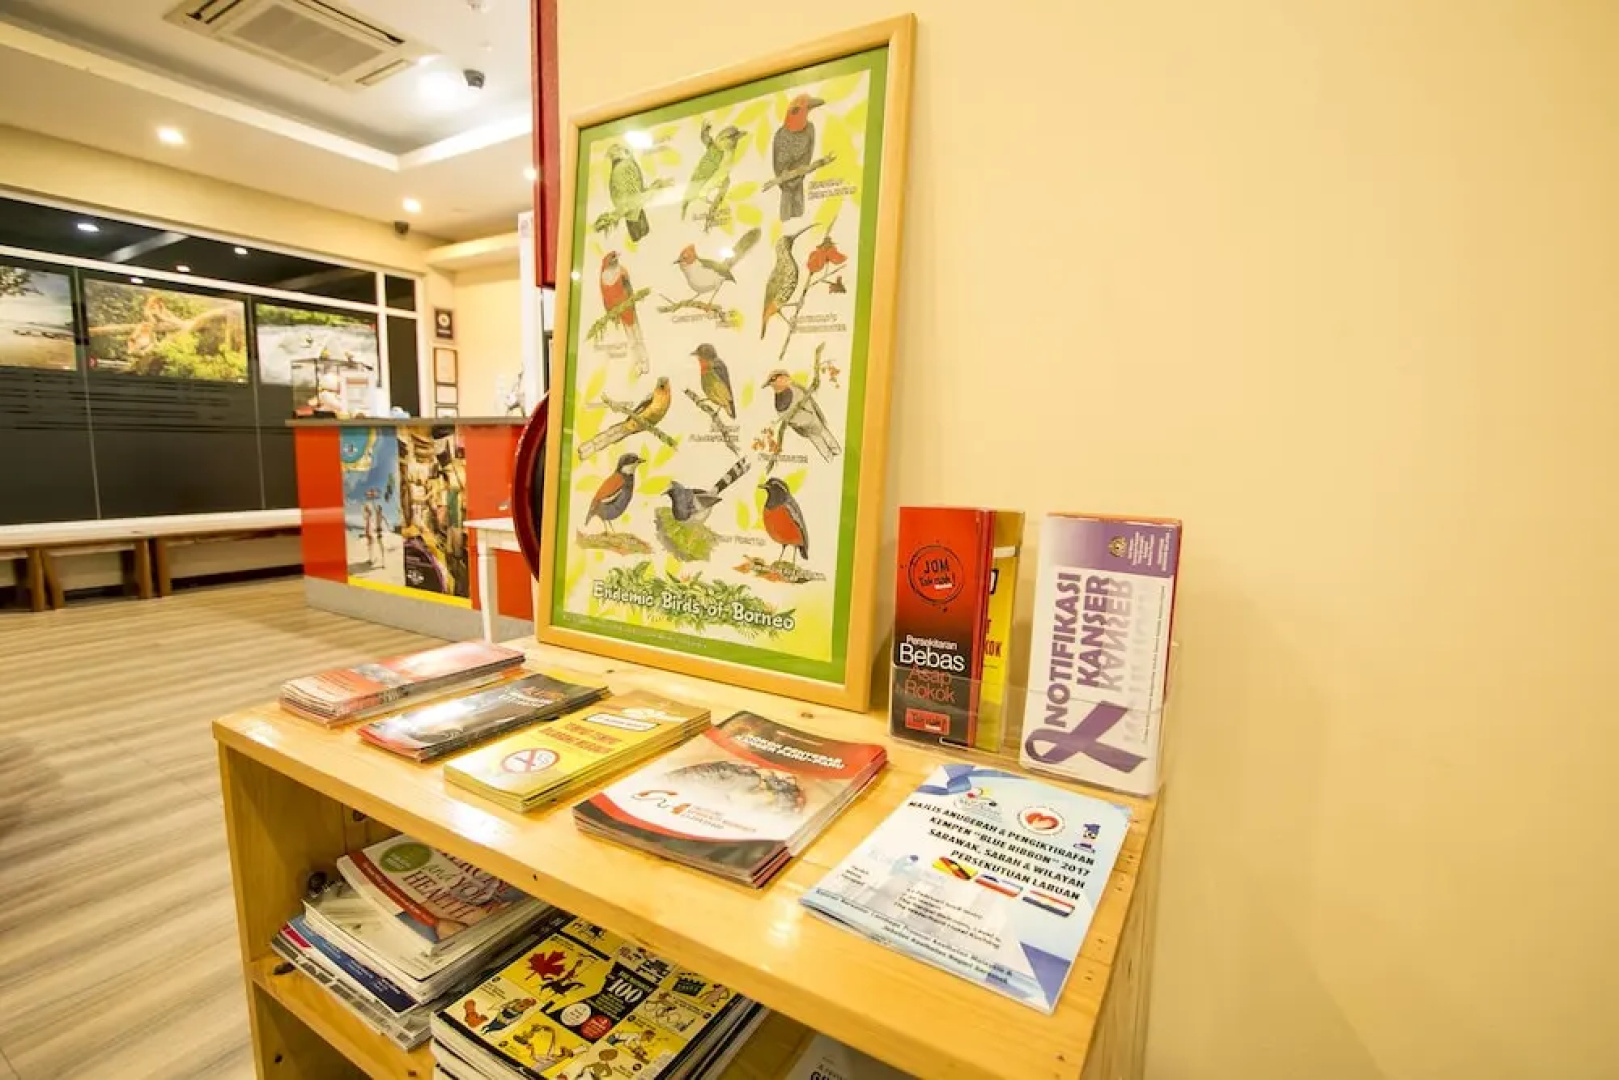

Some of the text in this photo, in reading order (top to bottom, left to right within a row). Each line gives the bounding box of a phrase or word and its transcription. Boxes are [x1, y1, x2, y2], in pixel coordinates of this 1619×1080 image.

[924, 558, 949, 574] JOM
[593, 580, 795, 630] Endemic Birds of Borneo
[906, 634, 958, 651] Persekitaran
[1044, 572, 1082, 729] NOTIFIKASI
[1076, 575, 1110, 688] KANSER
[899, 642, 966, 672] Bebas
[909, 664, 951, 686] Asap
[905, 680, 956, 704] Rokok
[928, 828, 1086, 889] SARAWAK, SABAH & WILAYAH
[929, 816, 972, 836] KEMPEN
[1061, 862, 1091, 877] 2017
[943, 809, 998, 832] ANUGERAH
[1008, 831, 1095, 866] PENGIKTIRAFAN
[951, 849, 1081, 900] PERSEKUTUAN LABUAN
[607, 978, 643, 1003] 100
